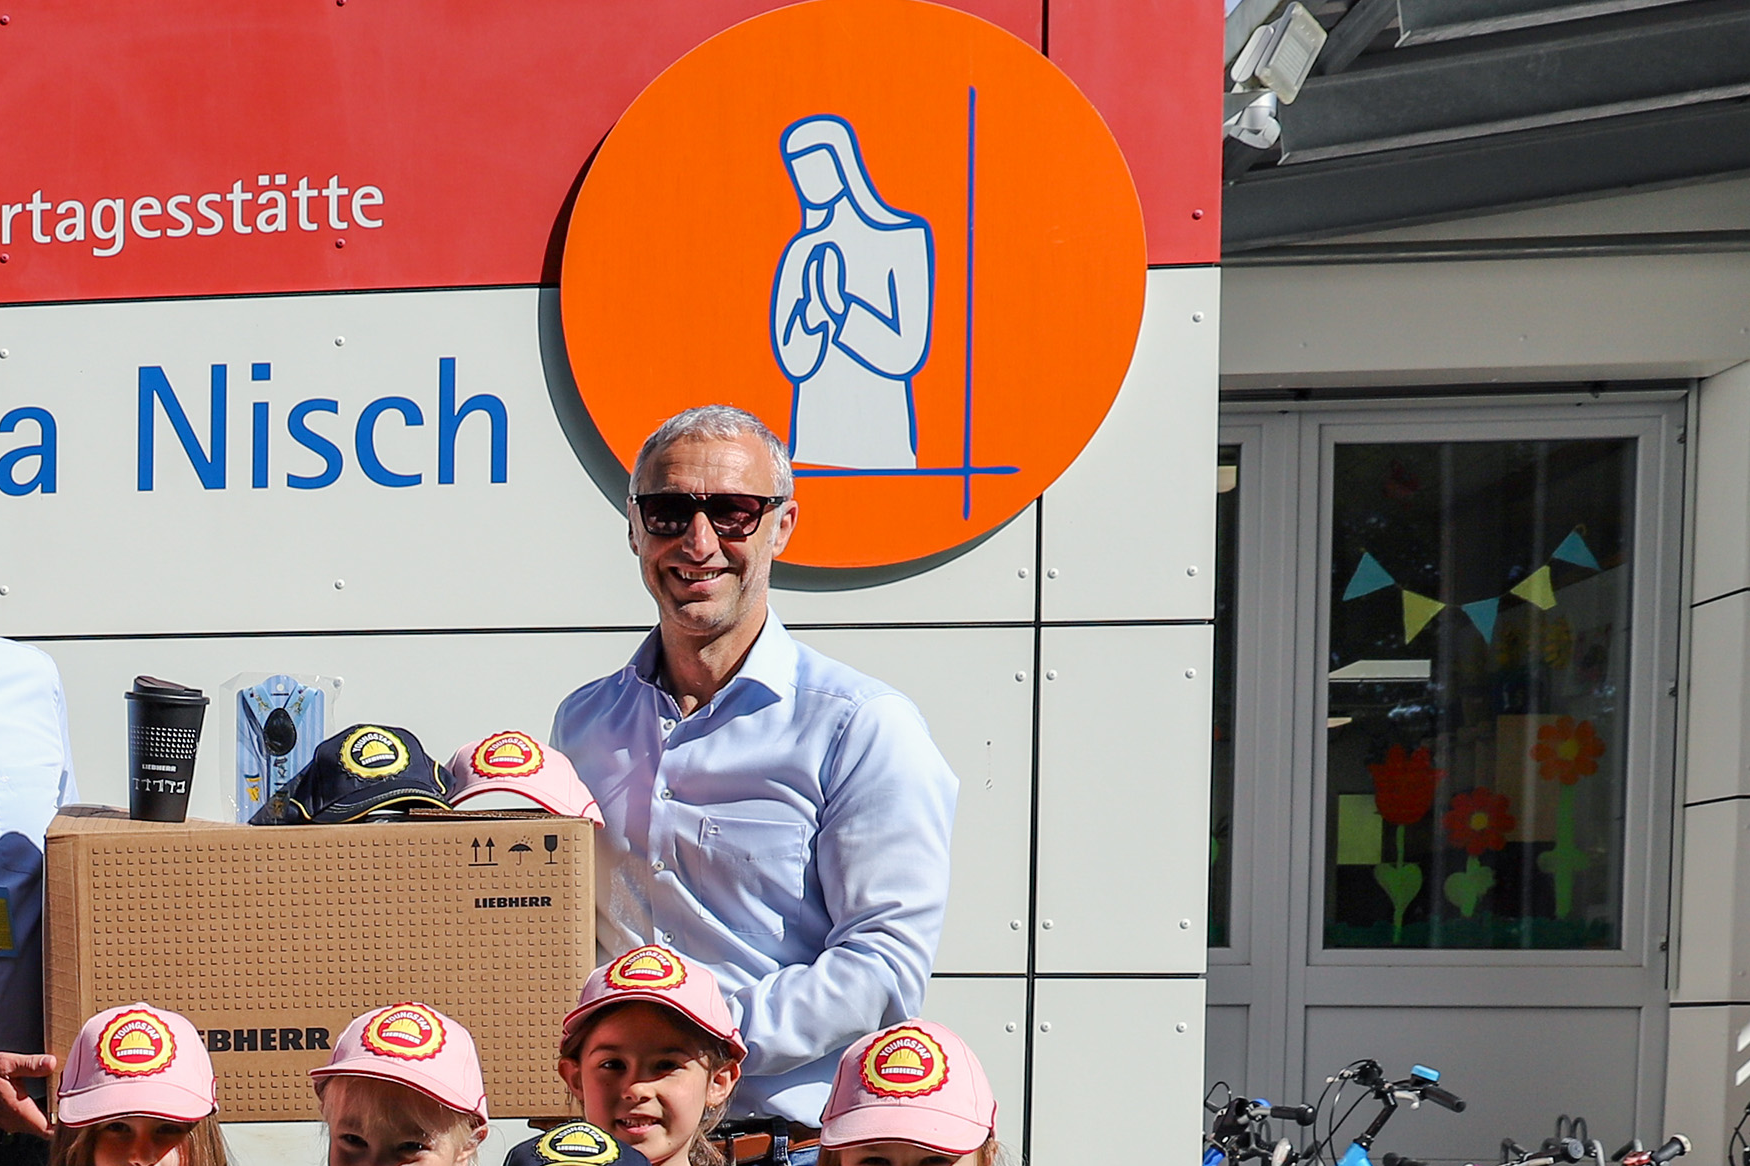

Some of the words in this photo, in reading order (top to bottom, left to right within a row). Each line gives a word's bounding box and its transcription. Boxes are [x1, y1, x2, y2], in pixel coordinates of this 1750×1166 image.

[138, 357, 508, 492] Nisch
[352, 733, 393, 753] YOUNGSTAR
[488, 738, 531, 752] YOUNGSTAR
[474, 896, 553, 909] LIEBHERR
[113, 1021, 161, 1040] YOUNGSTAR
[383, 1011, 431, 1031] YOUNGSTAR
[878, 1038, 932, 1060] YOUNGSTAR
[880, 1067, 925, 1077] LIEBHERR
